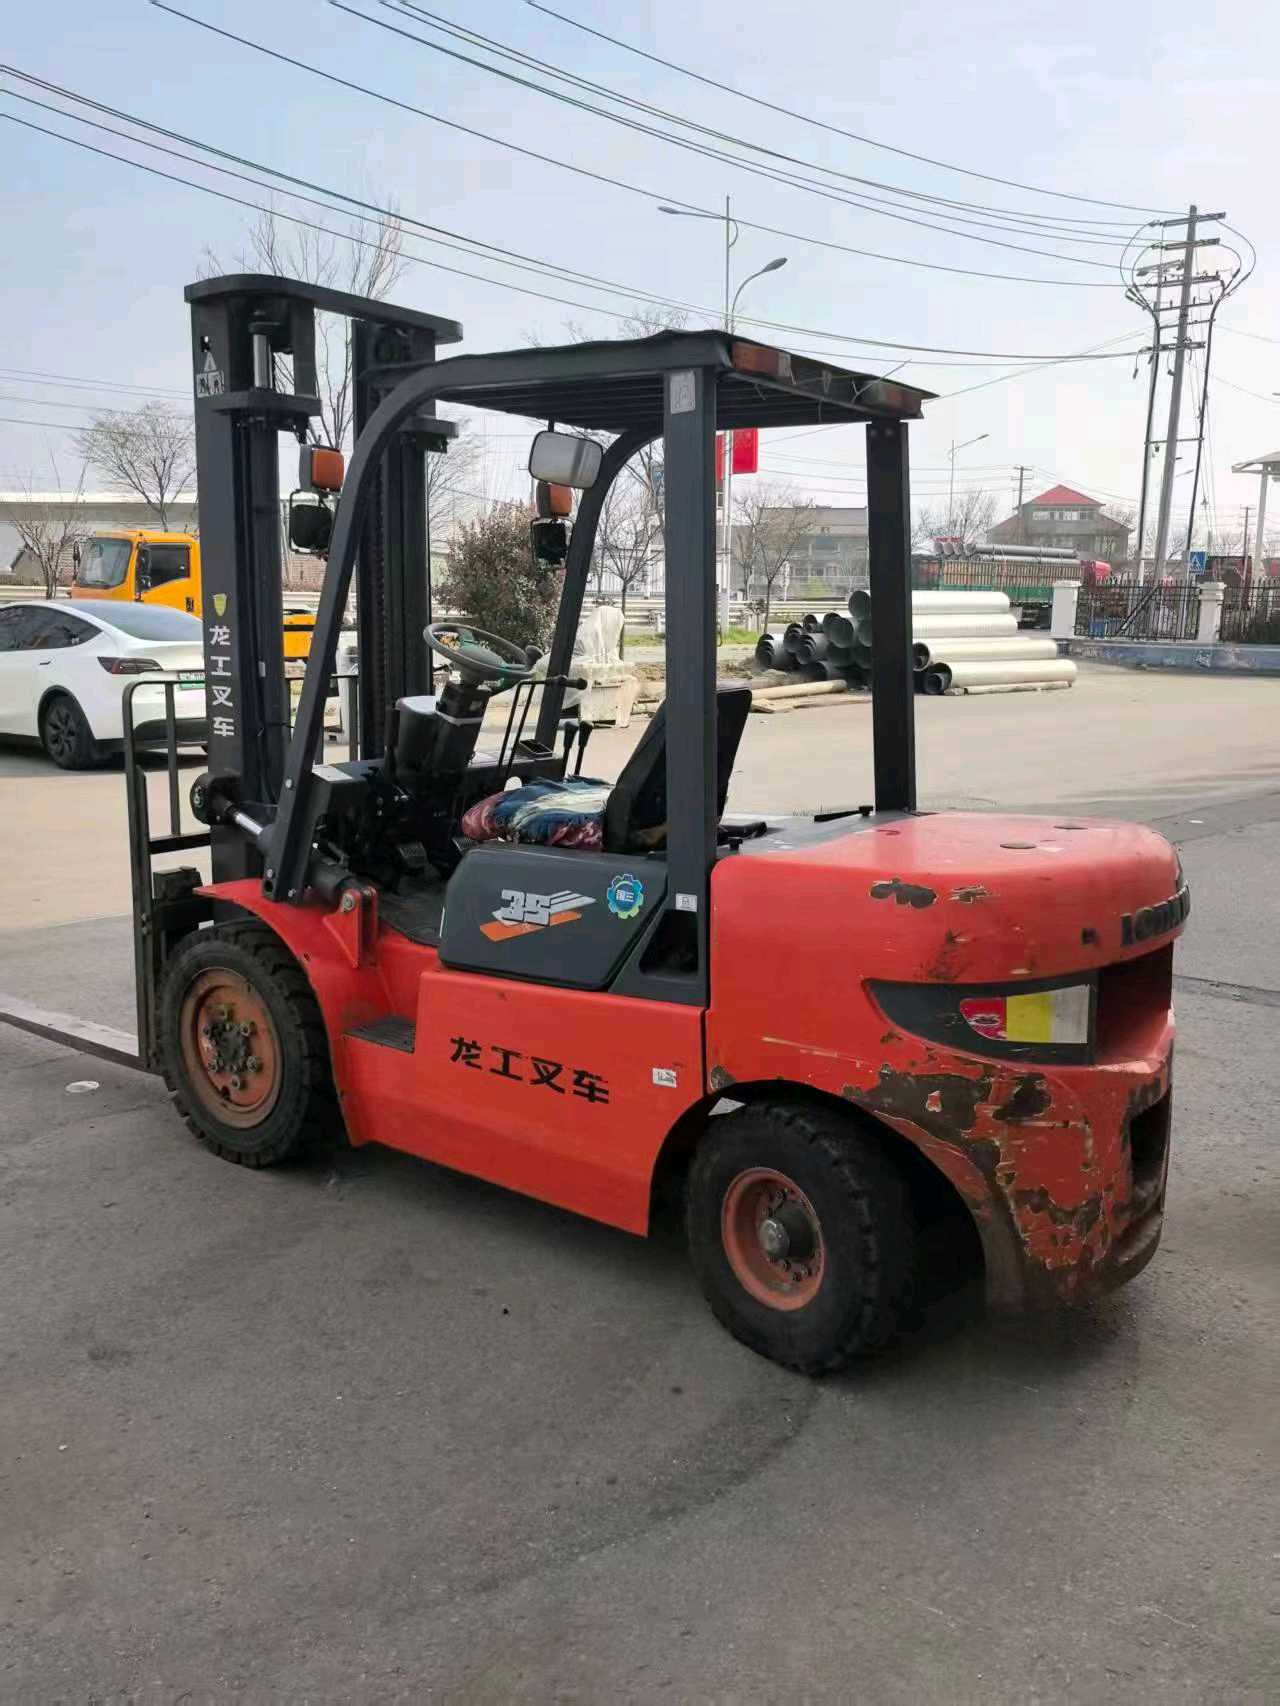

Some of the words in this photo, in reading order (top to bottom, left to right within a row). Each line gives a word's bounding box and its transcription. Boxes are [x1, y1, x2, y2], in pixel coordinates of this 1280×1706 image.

[209, 625, 235, 737] 龙工叉车
[501, 888, 551, 927] 35
[450, 1036, 609, 1104] 龙工叉车
